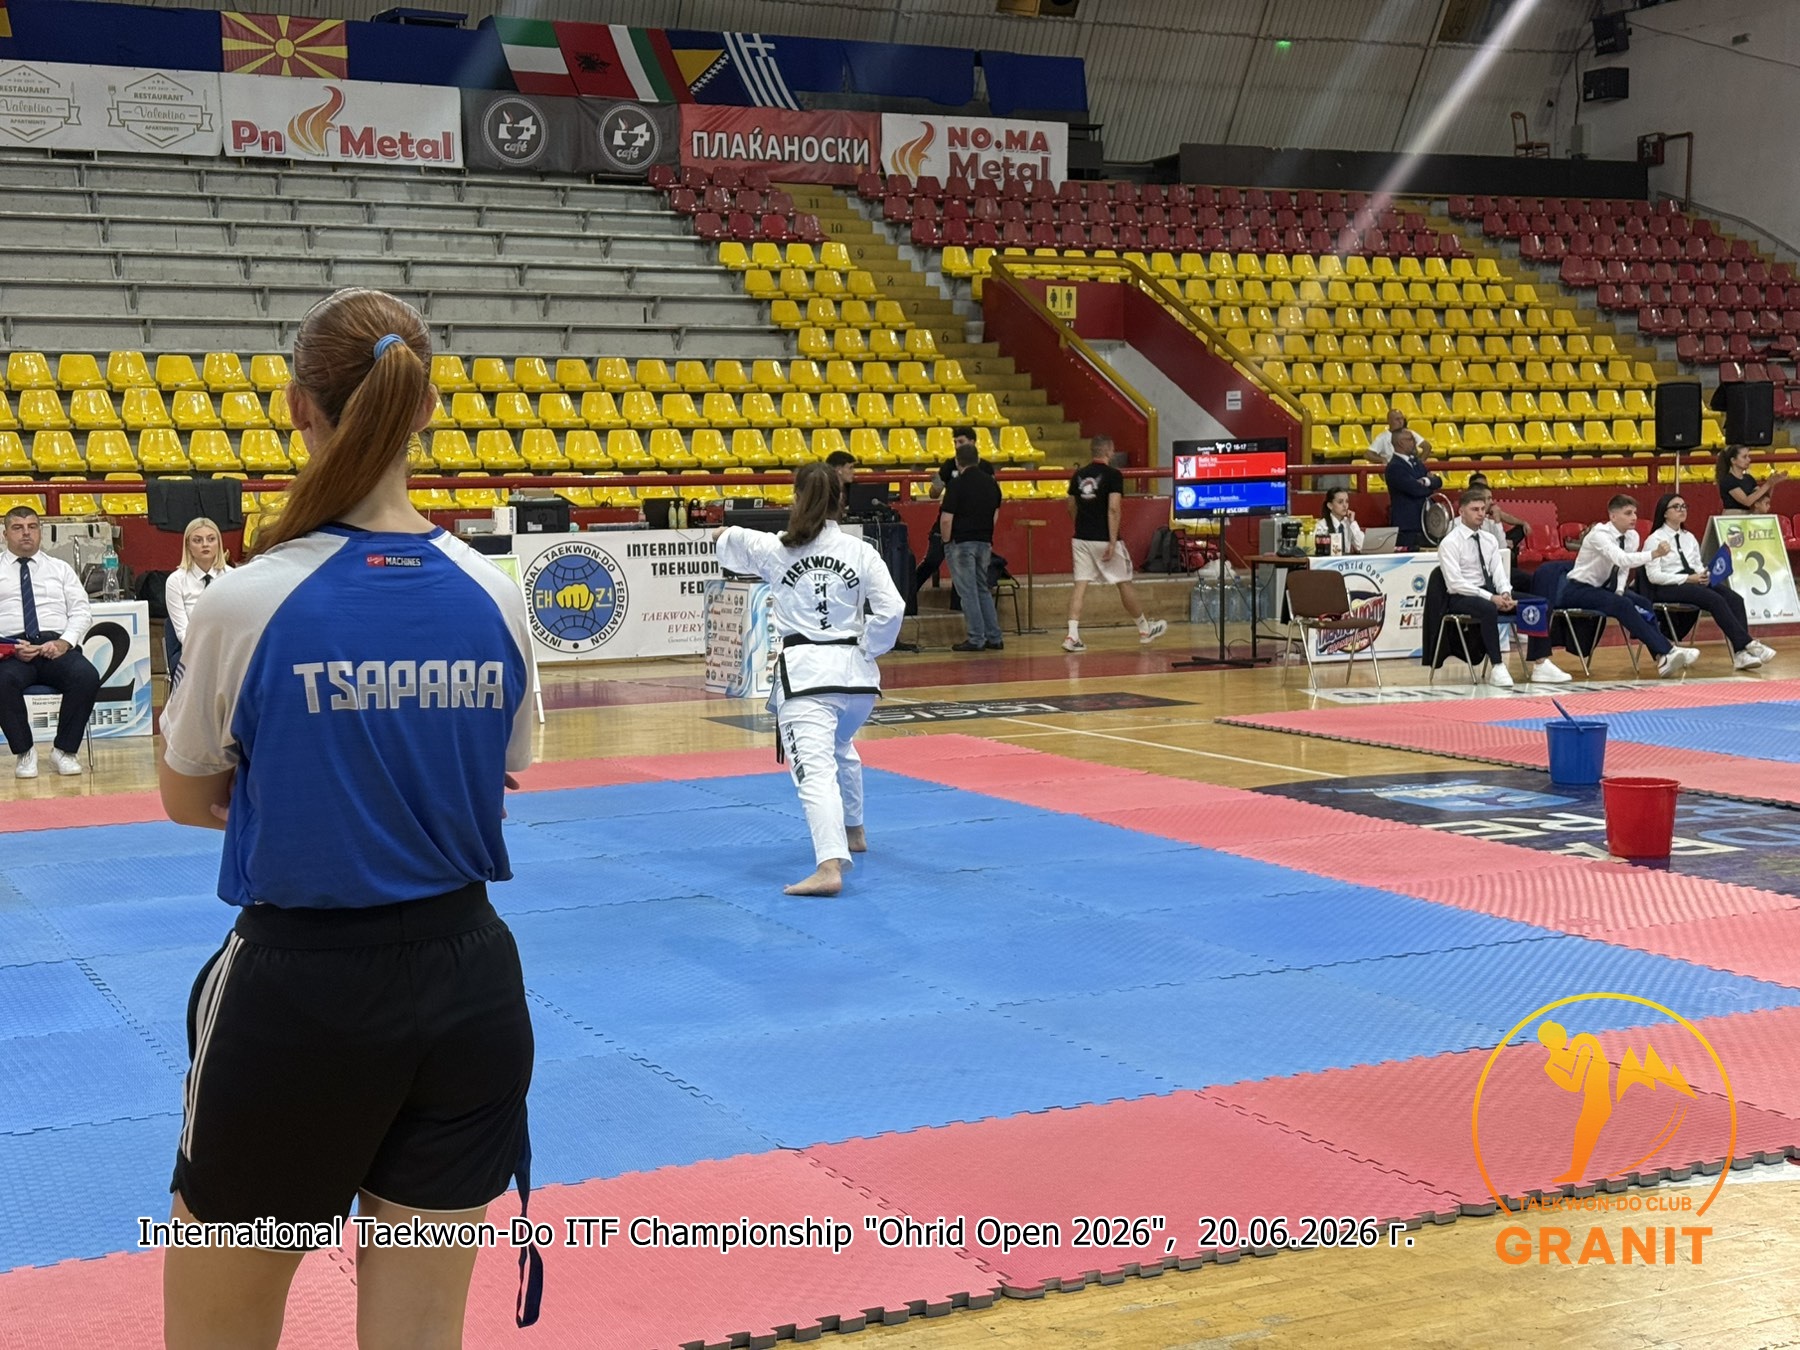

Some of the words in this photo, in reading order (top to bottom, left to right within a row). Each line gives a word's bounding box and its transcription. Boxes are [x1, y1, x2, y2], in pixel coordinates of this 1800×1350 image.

[134, 92, 183, 101] RESTAURANT
[134, 105, 186, 120] Valentino
[231, 120, 284, 153] Pn
[339, 125, 454, 162] Metal
[692, 126, 870, 164] ПЛАЌАНОСКИ
[947, 126, 1050, 154] NO.MA
[504, 141, 528, 155] café
[616, 147, 639, 160] café
[949, 152, 1050, 182] Metal
[809, 198, 820, 208] 11
[831, 224, 842, 234] 10
[857, 249, 864, 259] 9
[887, 276, 894, 286] 8
[913, 303, 919, 314] 7
[941, 330, 949, 343] 6
[975, 361, 982, 373] 5
[1002, 393, 1010, 405] 4
[1037, 427, 1044, 439] 3
[385, 556, 421, 567] MACHINES
[543, 545, 616, 573] TAEKWON-DO
[781, 556, 860, 589] TAEKWON-DO
[1338, 562, 1363, 572] Ohrid
[1366, 565, 1385, 584] Open
[1744, 550, 1772, 596] 3
[525, 566, 562, 648] INTERNIONAL
[590, 581, 626, 646] FEDERATION
[668, 624, 704, 633] EVERY
[83, 621, 136, 702] 2
[293, 660, 504, 713] TSAPARA
[866, 703, 1061, 721] LOGIS
